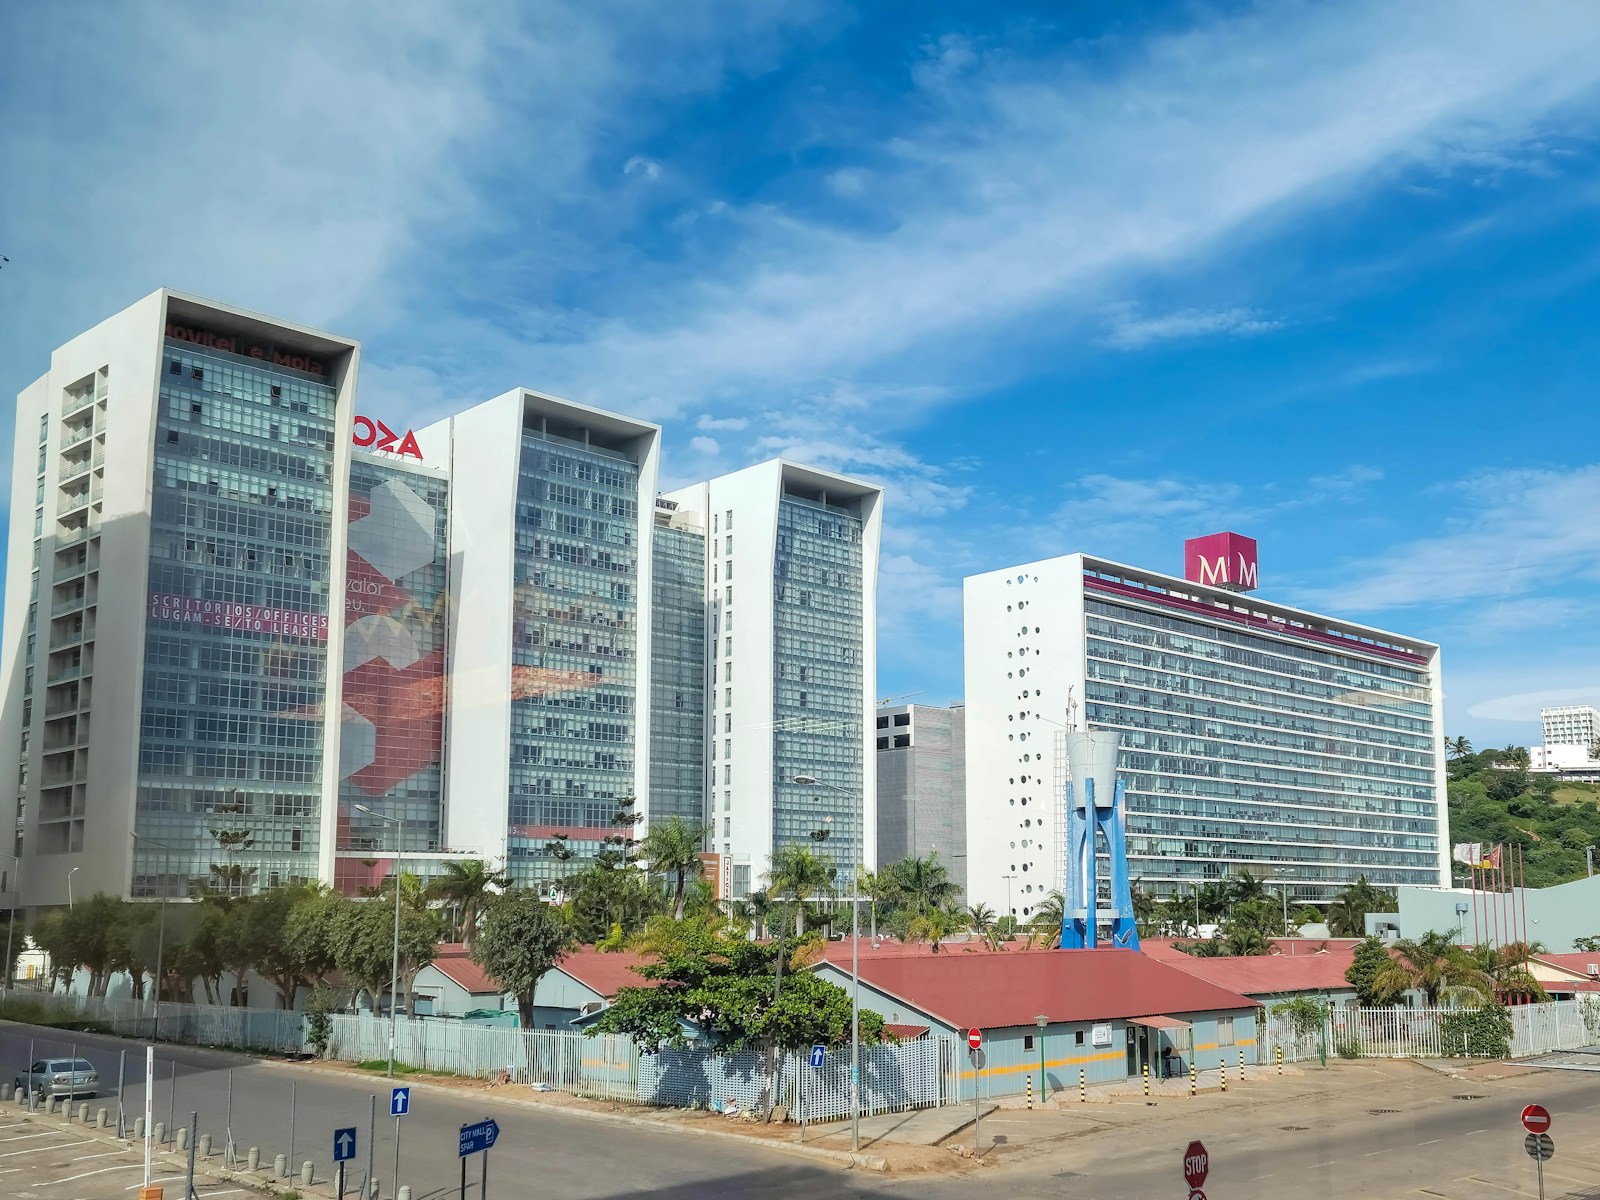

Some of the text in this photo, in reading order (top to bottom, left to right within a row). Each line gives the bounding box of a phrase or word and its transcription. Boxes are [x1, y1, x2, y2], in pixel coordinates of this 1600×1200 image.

[1197, 554, 1228, 585] M
[1237, 551, 1258, 589] M
[273, 624, 318, 638] LEASE
[460, 1127, 486, 1141] CITY MALL
[460, 1141, 474, 1152] SPAR
[1186, 1154, 1206, 1176] STOP
